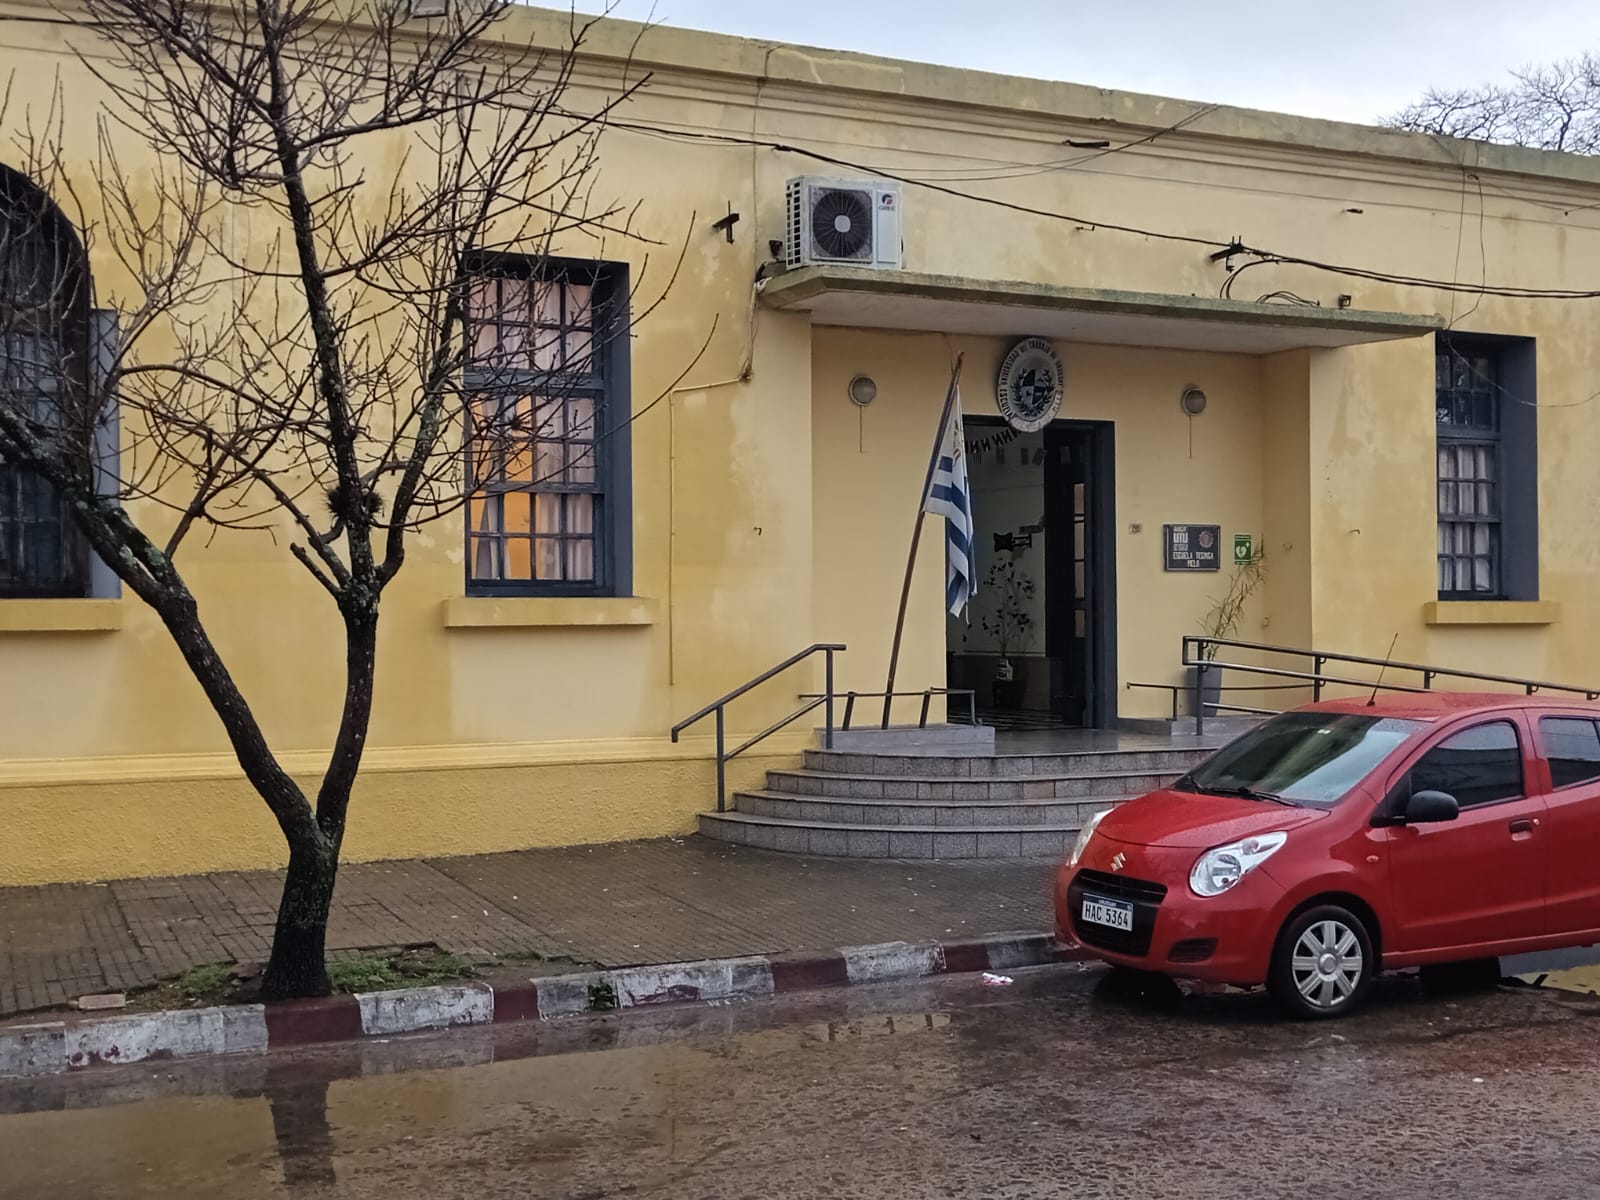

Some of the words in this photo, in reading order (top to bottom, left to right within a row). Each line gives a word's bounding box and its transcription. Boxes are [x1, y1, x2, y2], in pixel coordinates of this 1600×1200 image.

[1173, 532, 1189, 544] UTU
[1172, 551, 1194, 560] ESCUELA
[1187, 560, 1200, 568] MELO
[1085, 903, 1102, 921] HAC
[1106, 908, 1128, 927] 5364
